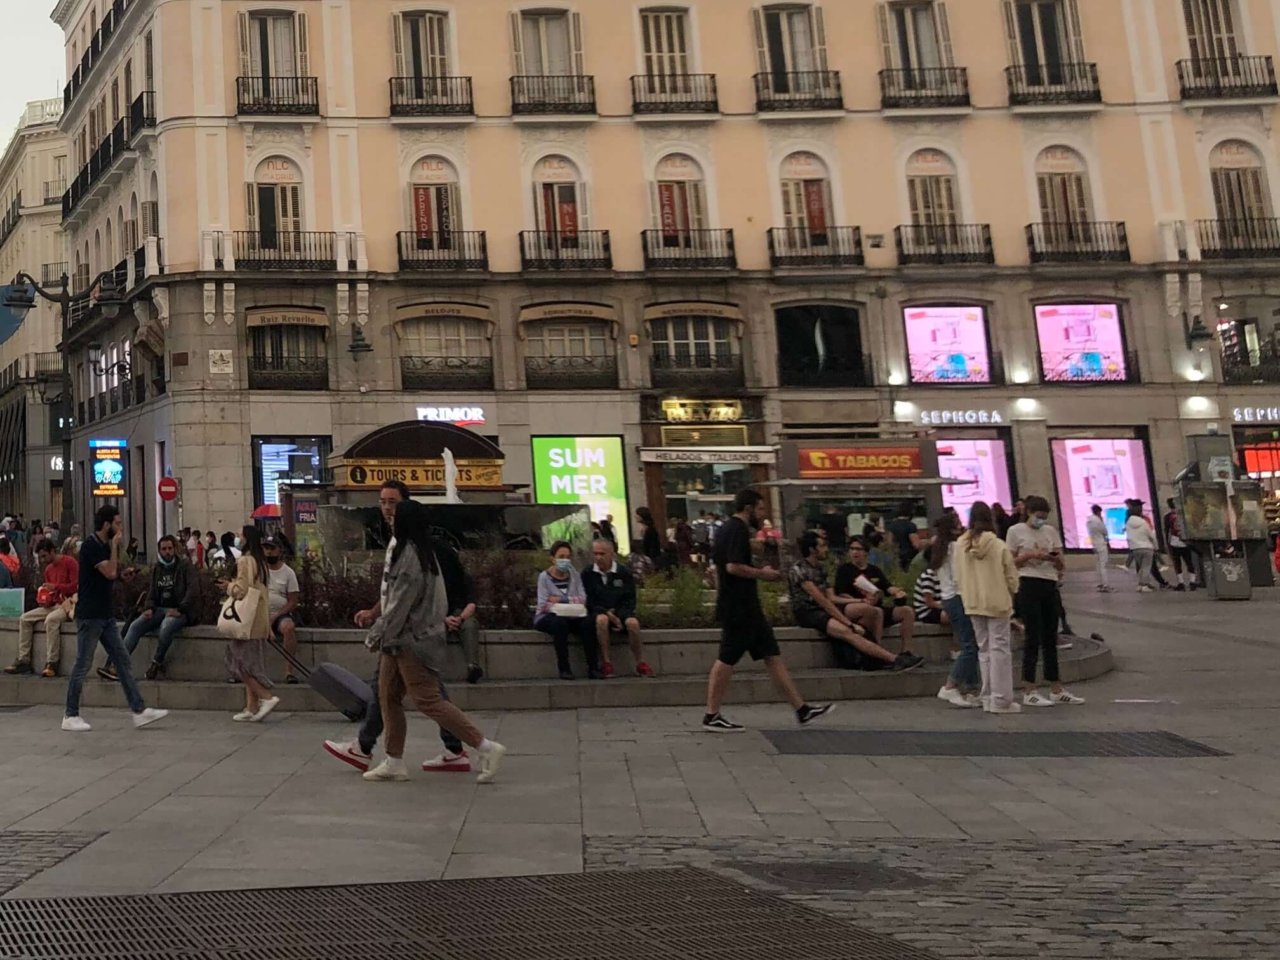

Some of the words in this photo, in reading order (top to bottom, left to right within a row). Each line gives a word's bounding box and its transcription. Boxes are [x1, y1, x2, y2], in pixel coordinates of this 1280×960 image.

[416, 407, 486, 421] PRIMOR
[921, 409, 1003, 424] SEPHORA
[548, 447, 605, 468] SUM
[655, 452, 703, 462] HELADOS
[709, 452, 760, 462] ITALIANOS
[836, 455, 912, 468] TABACOS
[370, 468, 407, 482] TOURS
[410, 469, 419, 481] &
[423, 468, 472, 482] TICTS
[550, 474, 608, 495] MER
